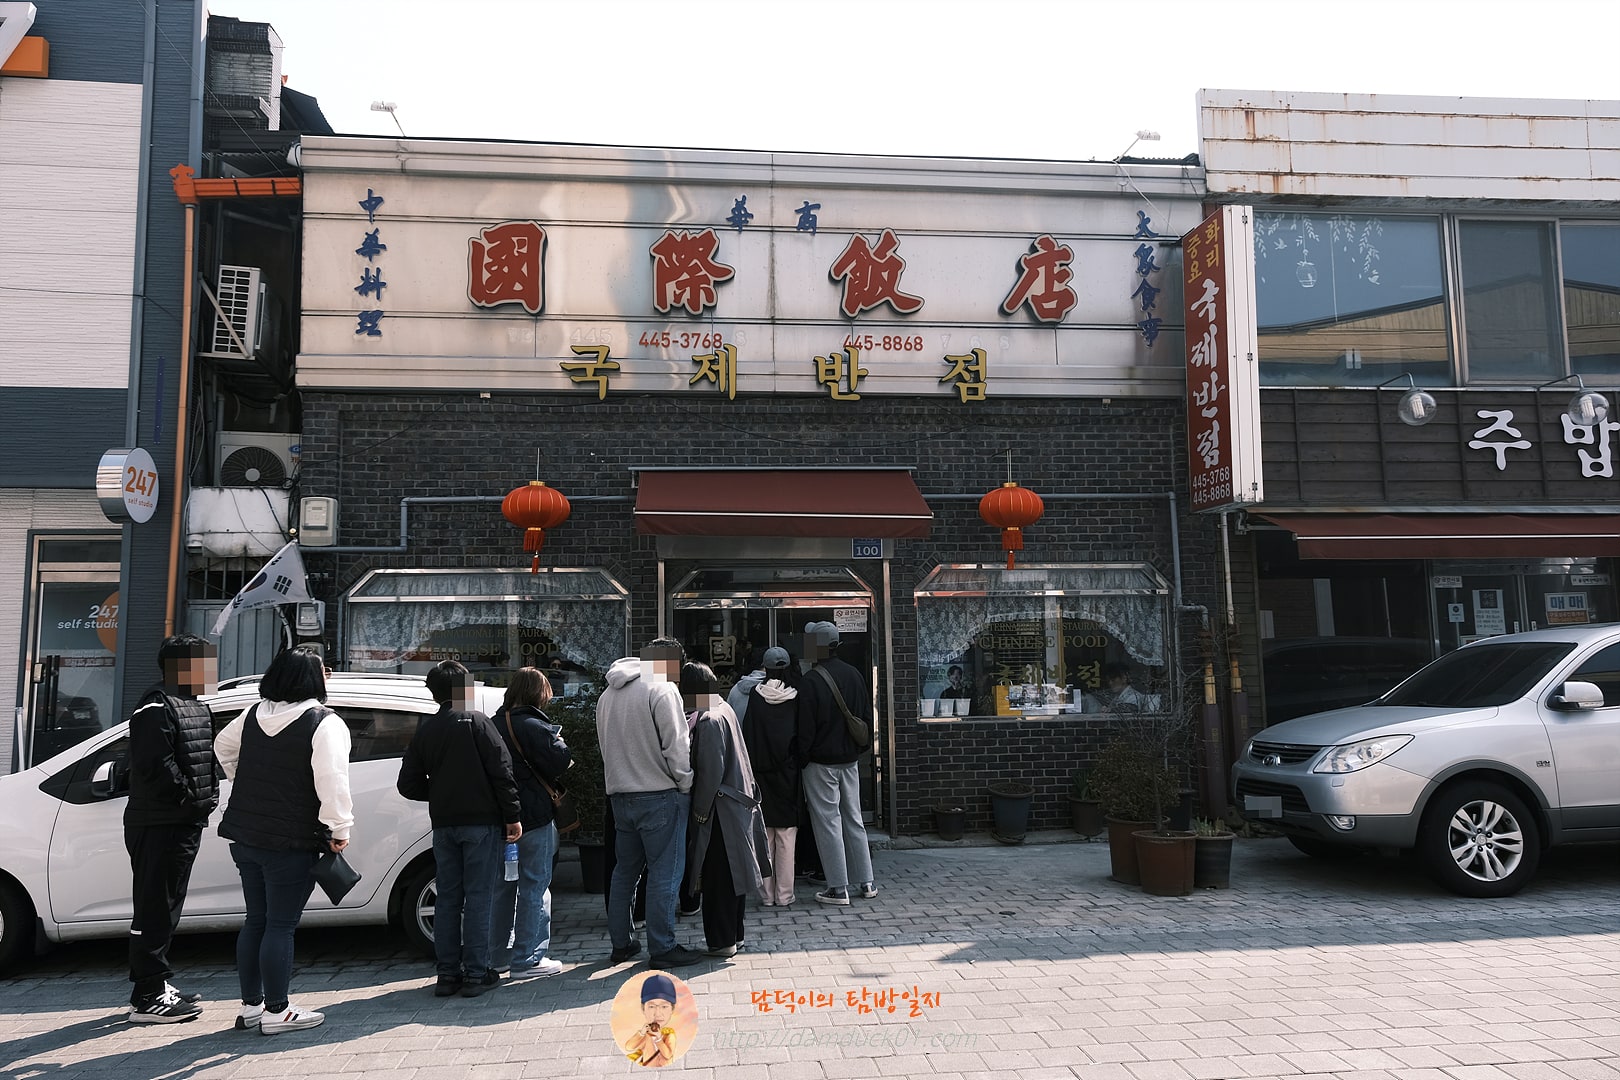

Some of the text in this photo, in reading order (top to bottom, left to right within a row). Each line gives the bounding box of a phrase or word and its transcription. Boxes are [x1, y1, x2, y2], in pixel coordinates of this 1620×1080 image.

[467, 219, 1077, 323] 國際飯店
[638, 332, 723, 349] 445-3768
[843, 335, 924, 351] 445-8868
[559, 343, 988, 404] 국제반점
[1190, 278, 1226, 469] 국제반점
[125, 466, 157, 497] 247
[1192, 466, 1230, 489] 445-3768
[1193, 483, 1231, 505] 445-8868
[856, 546, 879, 556] 100
[88, 604, 119, 619] 247
[57, 618, 82, 629] self
[979, 634, 1109, 650] CHINESE FOOD
